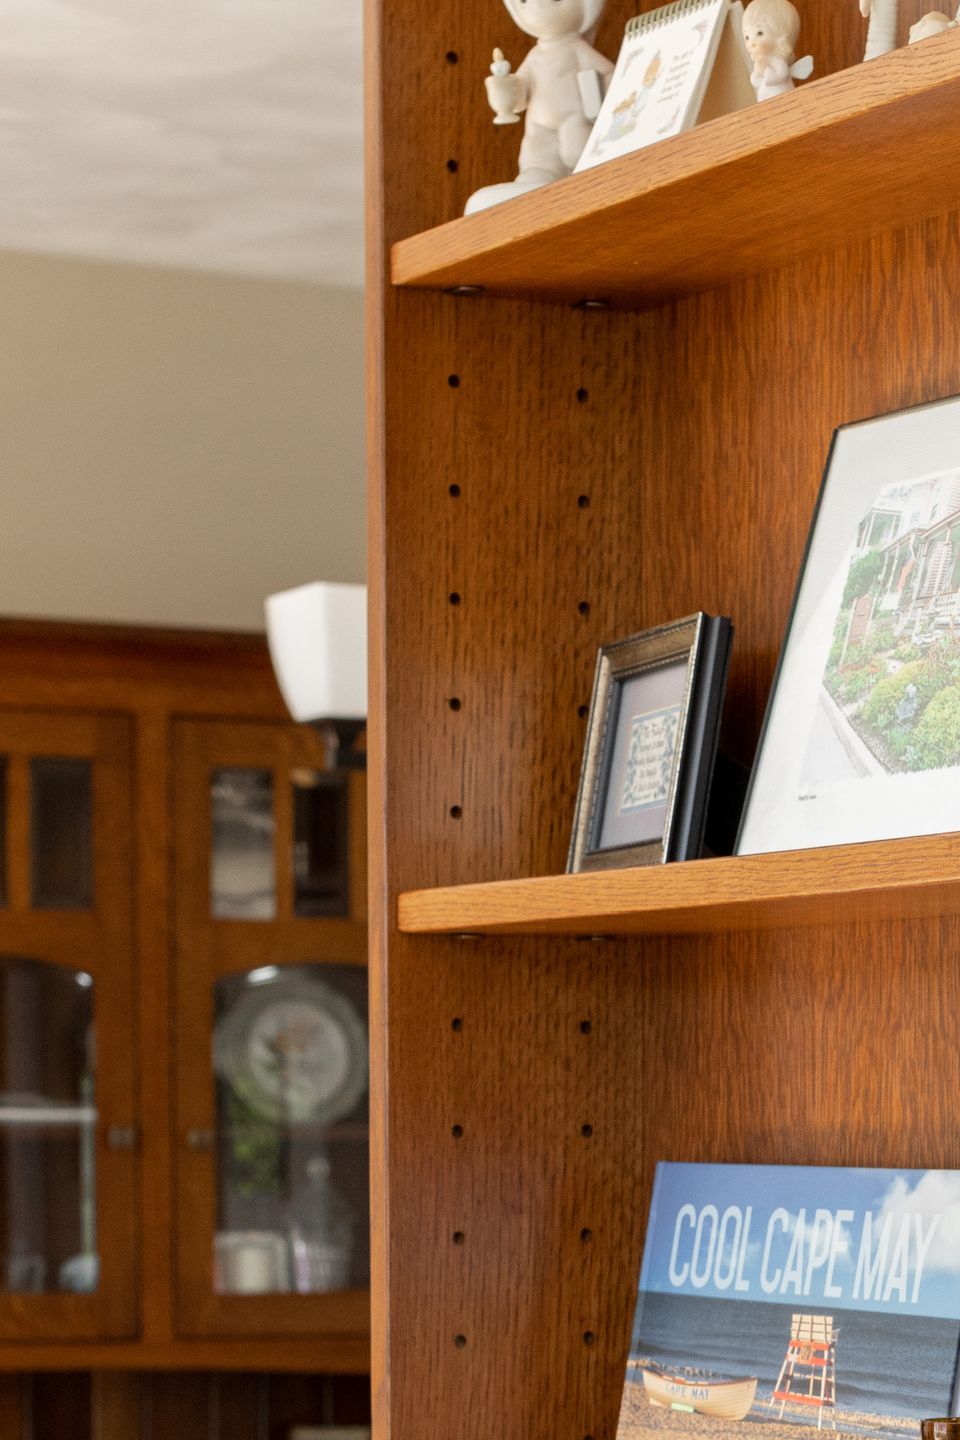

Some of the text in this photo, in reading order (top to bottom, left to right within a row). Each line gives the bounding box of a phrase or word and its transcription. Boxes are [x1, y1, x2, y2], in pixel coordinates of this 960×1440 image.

[668, 1203, 941, 1303] COOL CAPE MAY
[665, 1383, 709, 1400] CAPE MAY
